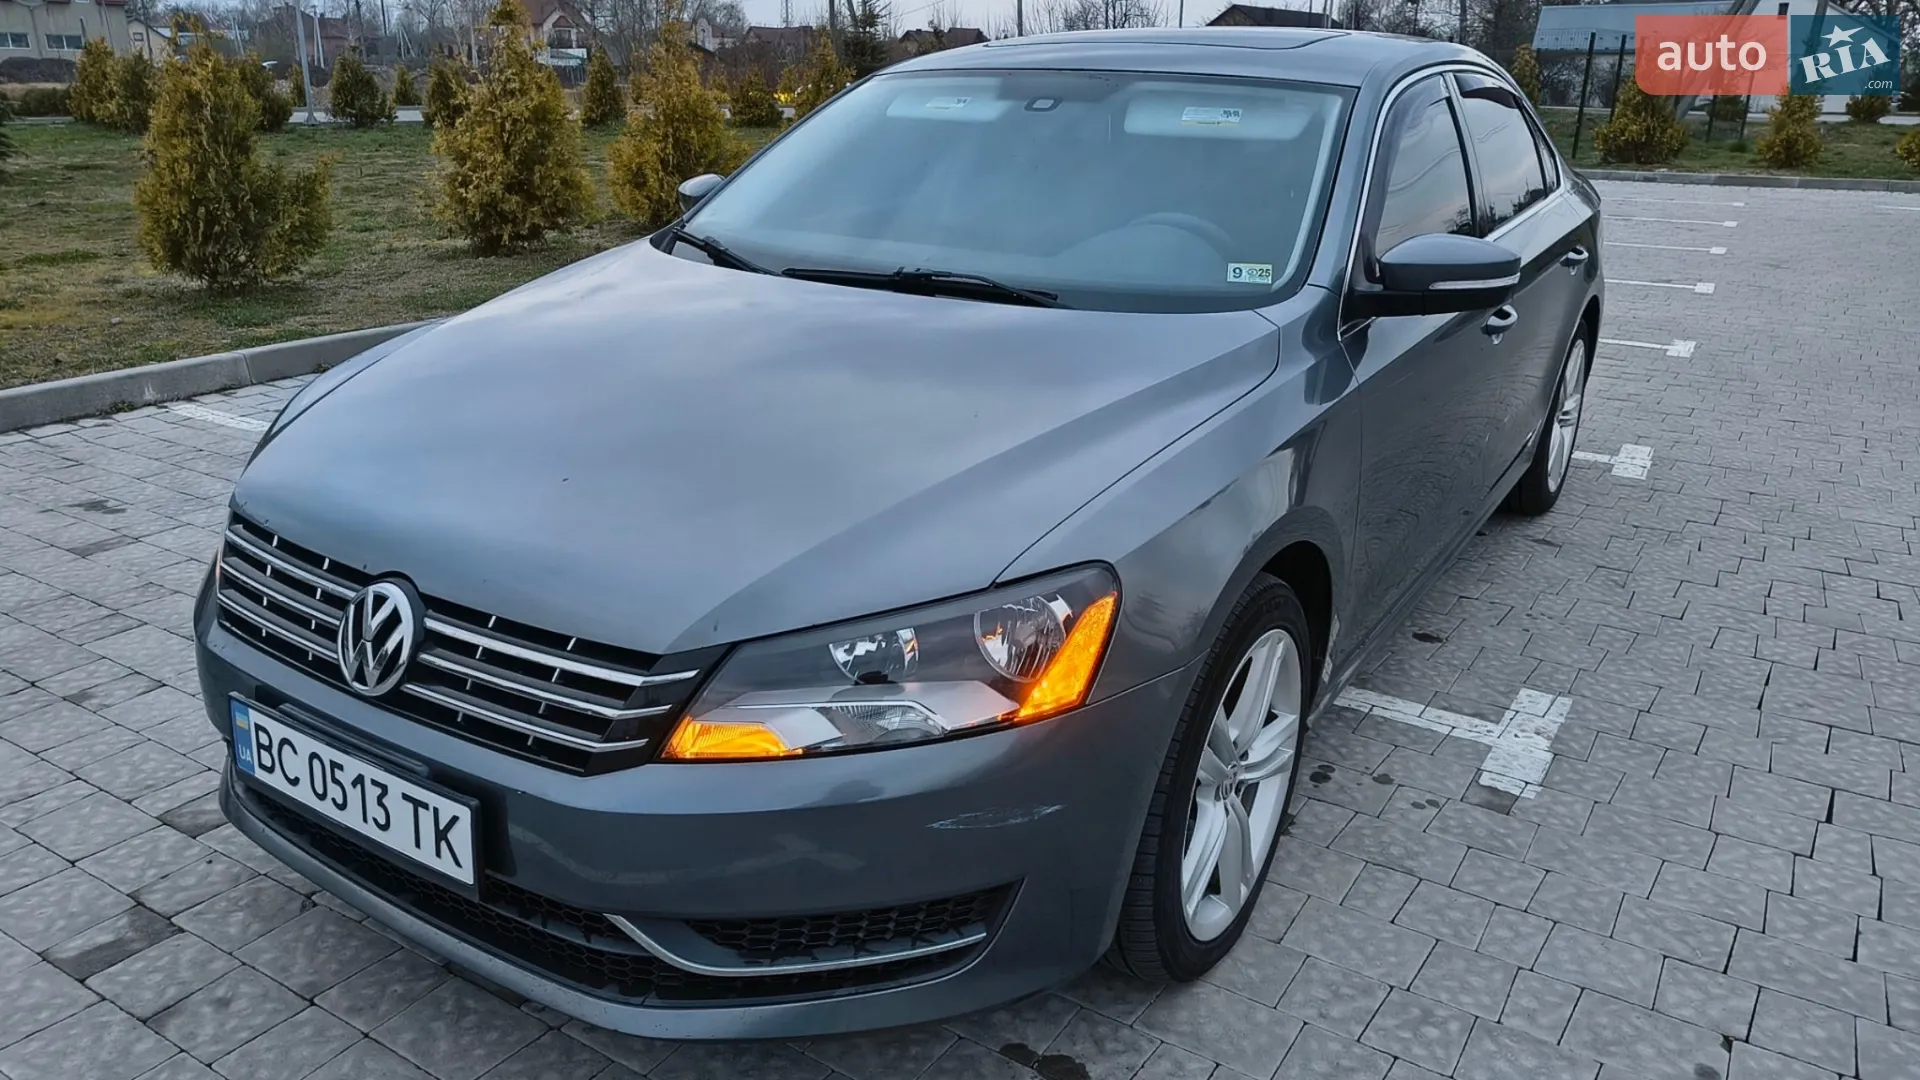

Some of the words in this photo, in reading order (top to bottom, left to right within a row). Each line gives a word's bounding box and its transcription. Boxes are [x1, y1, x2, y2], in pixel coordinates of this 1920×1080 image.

[1232, 267, 1243, 279] 9
[1258, 268, 1271, 278] 25
[238, 744, 253, 764] UA
[254, 722, 300, 787] BC
[308, 751, 391, 832] 0513
[401, 792, 463, 869] TK
